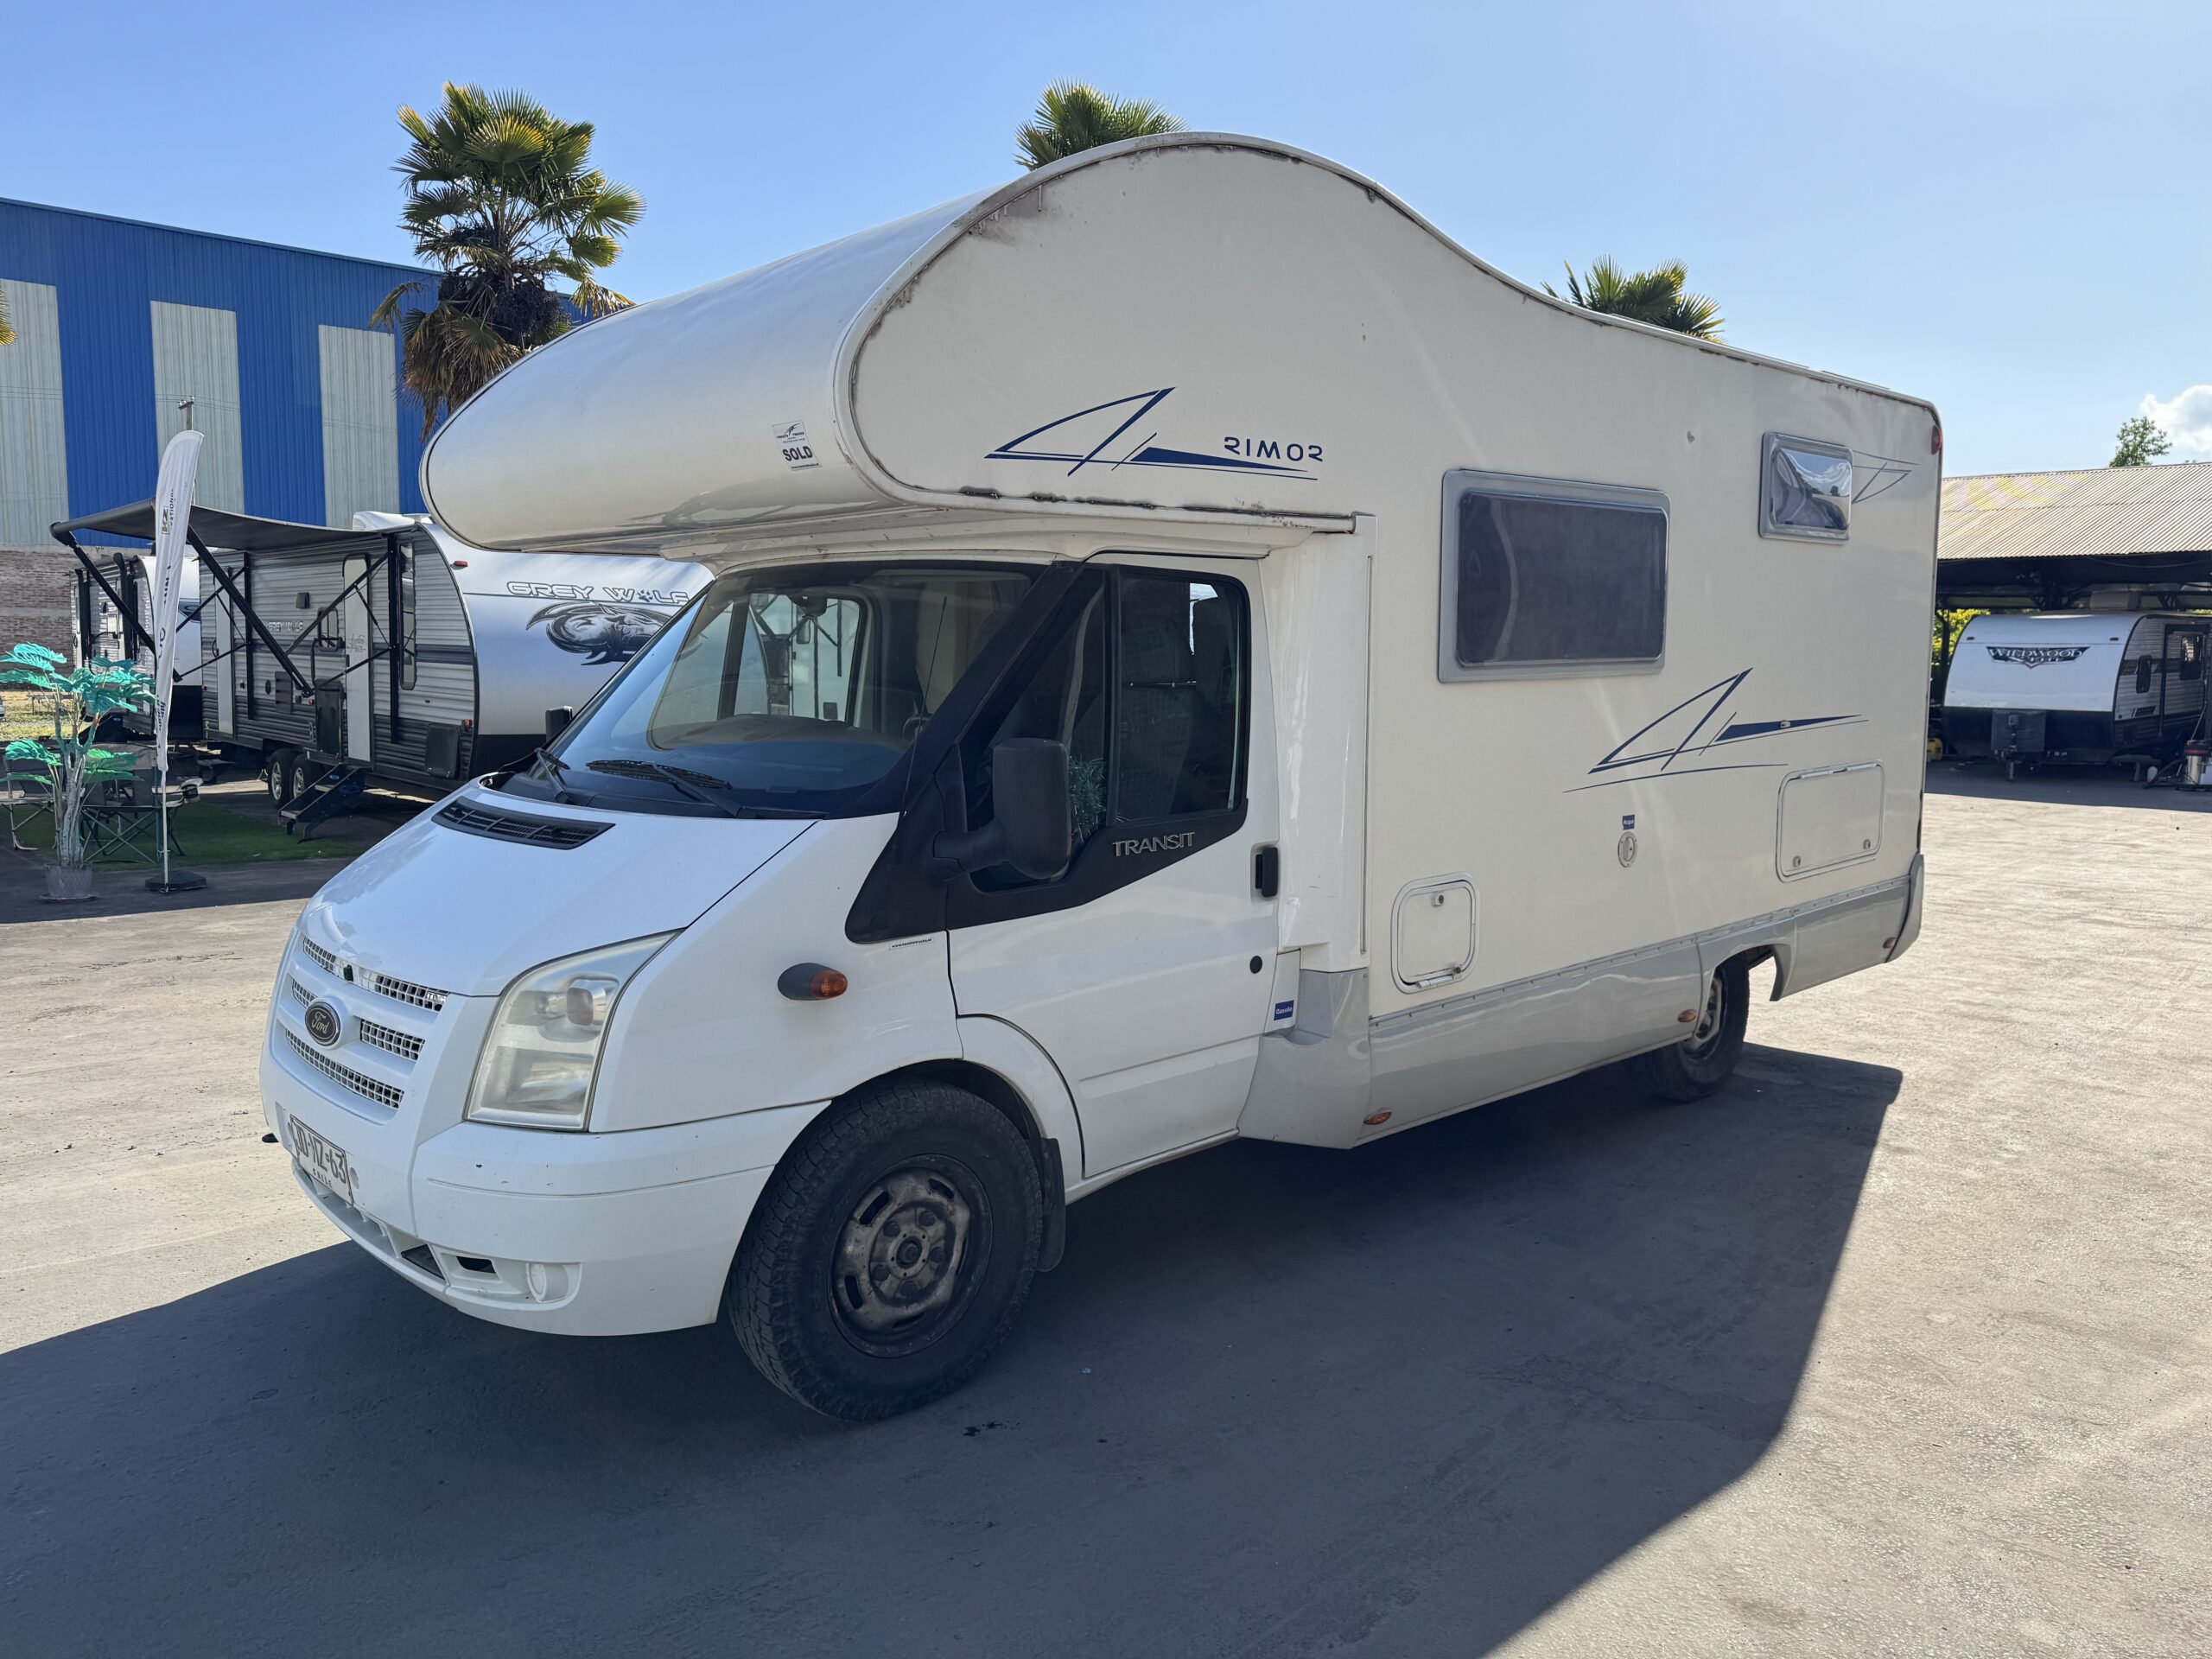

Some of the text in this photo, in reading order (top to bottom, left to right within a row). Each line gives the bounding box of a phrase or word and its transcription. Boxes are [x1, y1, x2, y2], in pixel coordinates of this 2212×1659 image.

[782, 445, 813, 462] SOLD
[1224, 435, 1324, 462] RIMOR
[506, 581, 594, 600] GREY
[1112, 831, 1196, 857] TRANSIT
[311, 1011, 330, 1034] Ford
